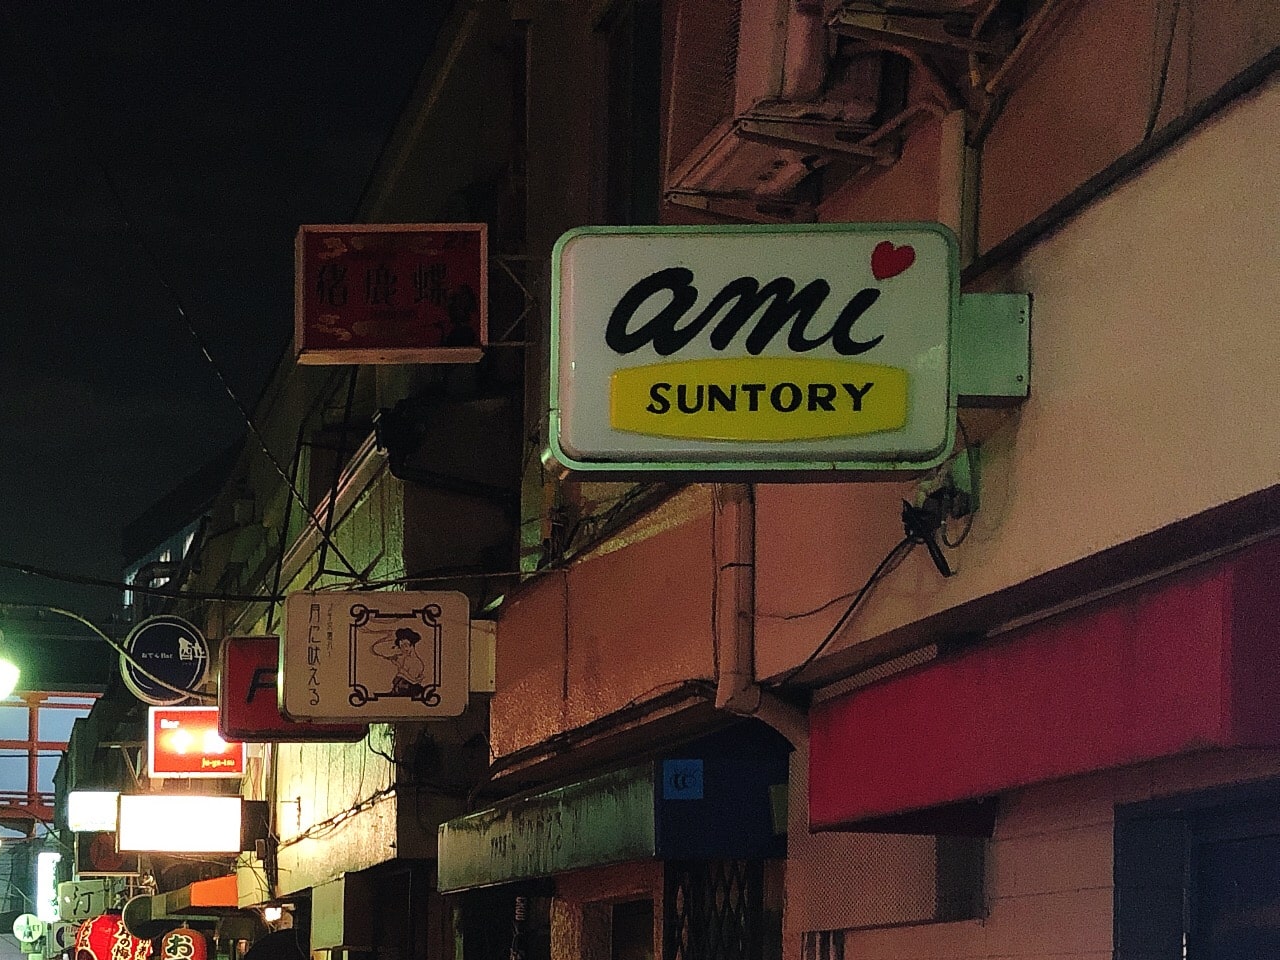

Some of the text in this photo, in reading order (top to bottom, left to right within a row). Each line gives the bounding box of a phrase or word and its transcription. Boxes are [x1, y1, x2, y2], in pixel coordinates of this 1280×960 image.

[605, 264, 884, 356] ami
[645, 381, 875, 415] SUNTORY
[307, 604, 321, 706] 月に吠える
